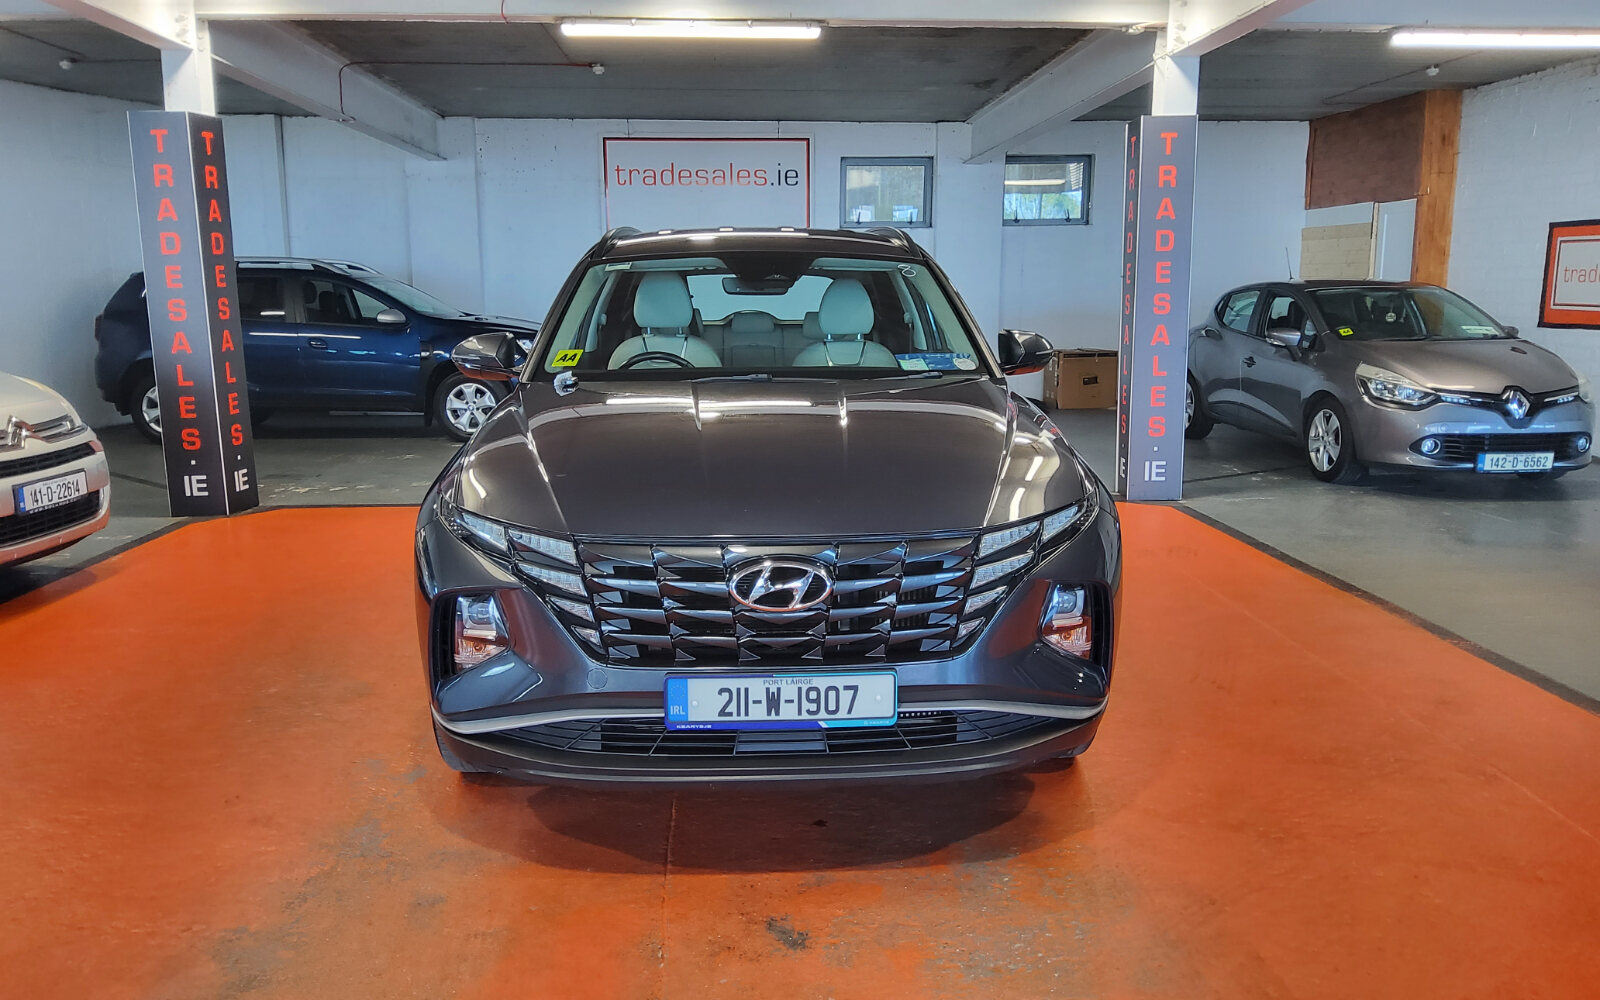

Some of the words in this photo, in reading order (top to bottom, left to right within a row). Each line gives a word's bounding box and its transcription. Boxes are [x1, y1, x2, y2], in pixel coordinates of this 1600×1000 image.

[614, 162, 799, 186] tradesales.ie
[1563, 264, 1600, 283] trad
[556, 353, 578, 363] AA
[1490, 456, 1549, 469] 142-D-6562
[30, 479, 80, 507] 141-D-22614
[785, 677, 814, 685] LÁIRGE
[717, 685, 860, 717] 211-W-1907
[670, 705, 686, 716] IRL
